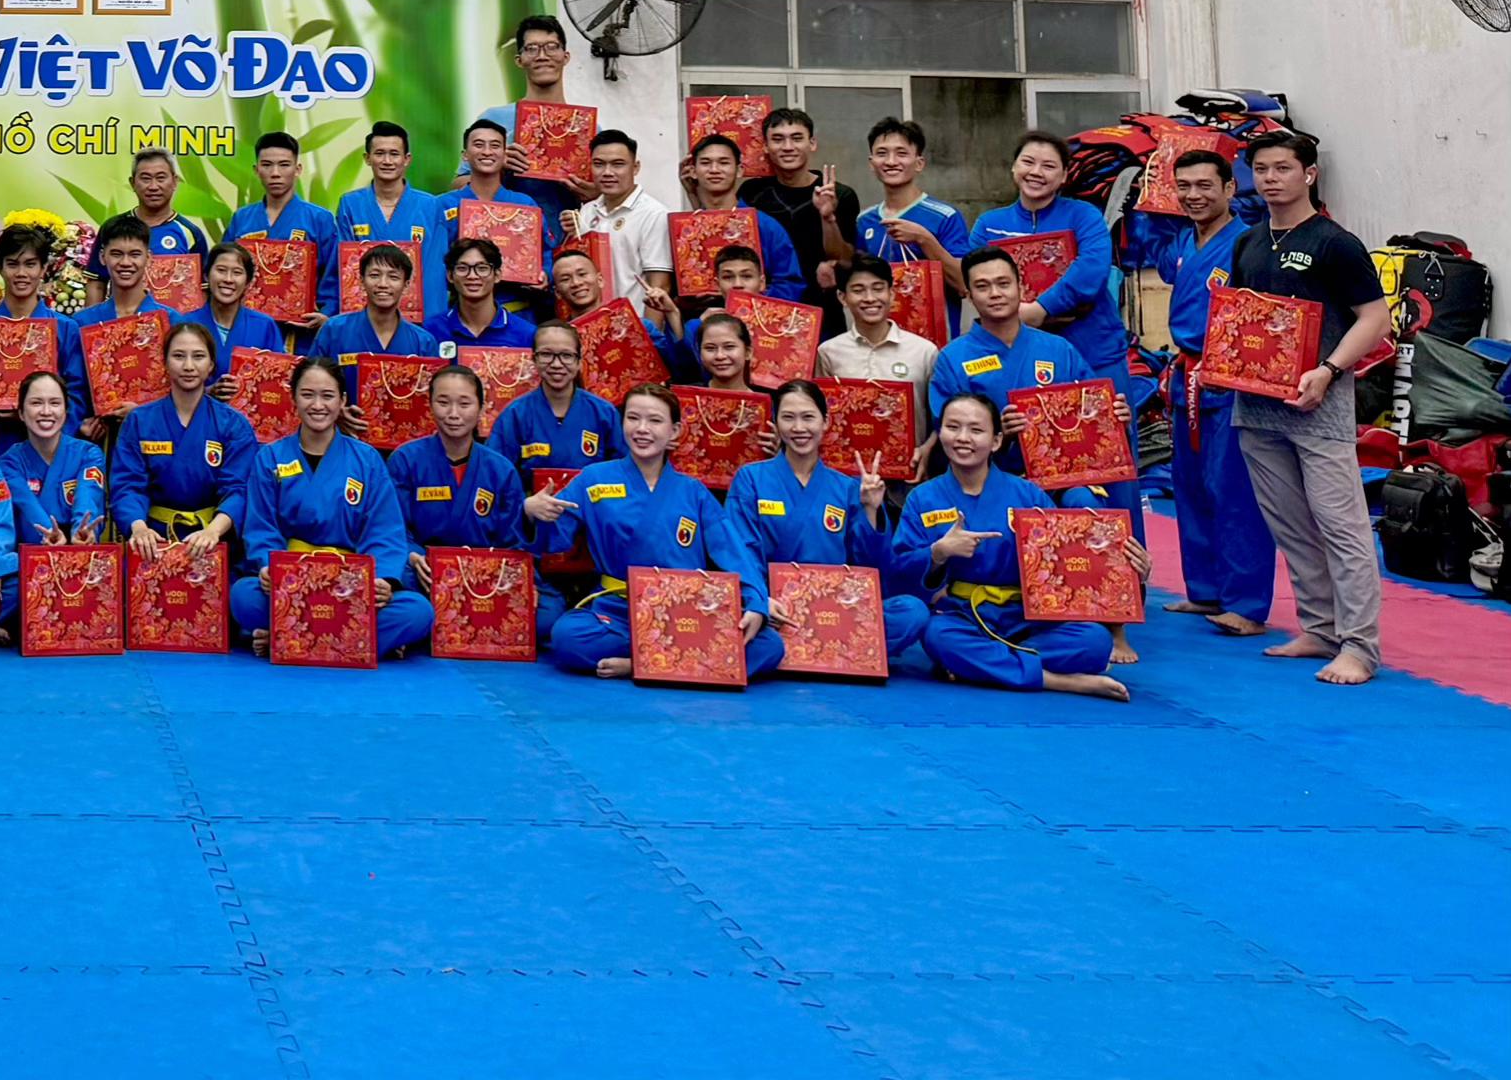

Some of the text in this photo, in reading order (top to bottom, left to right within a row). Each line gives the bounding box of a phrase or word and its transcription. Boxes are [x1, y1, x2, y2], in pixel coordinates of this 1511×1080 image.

[128, 35, 217, 91] VÕ
[228, 35, 370, 102] ĐẠO
[47, 116, 120, 155] CHÍ
[130, 125, 235, 155] MINH
